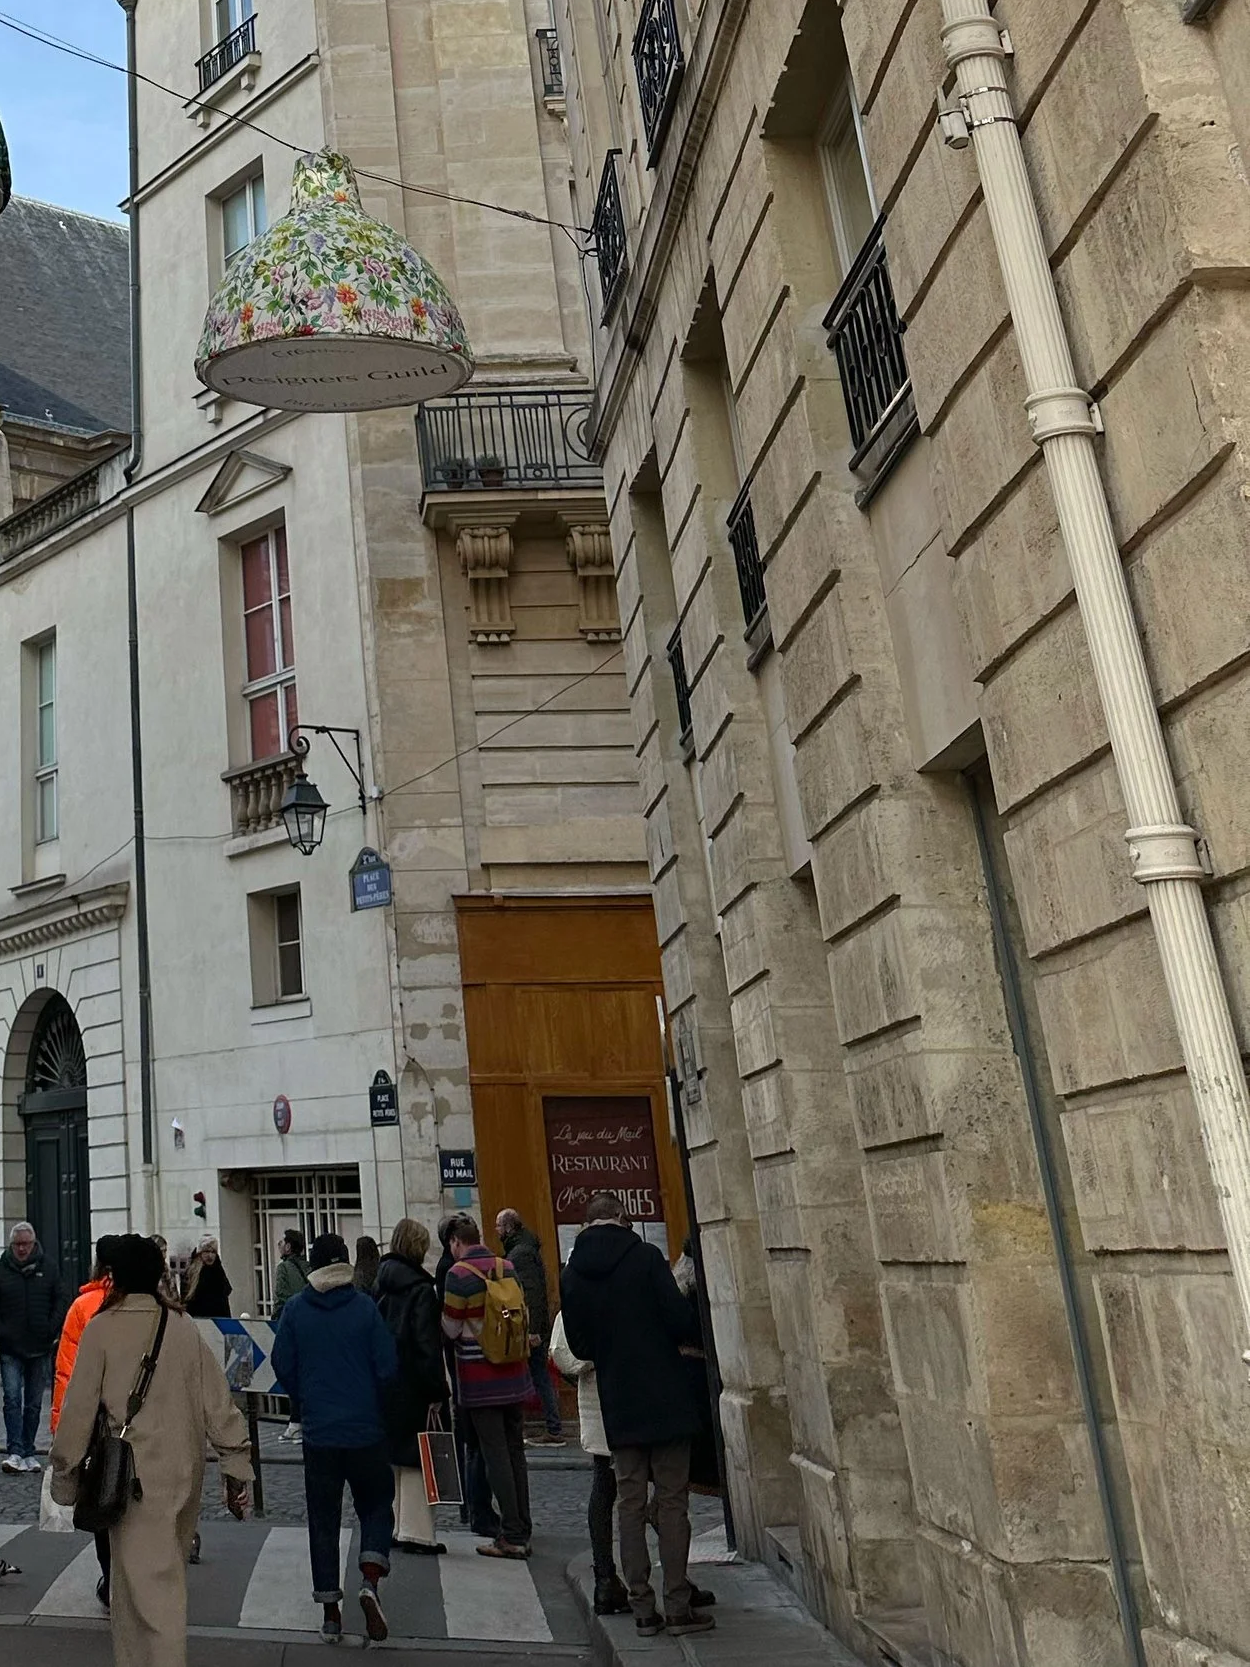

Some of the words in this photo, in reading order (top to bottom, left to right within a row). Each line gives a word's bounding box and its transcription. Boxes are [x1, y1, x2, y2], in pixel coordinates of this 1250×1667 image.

[221, 373, 360, 386] Designers
[367, 363, 448, 381] Guild
[362, 871, 380, 884] PLACE
[596, 1127, 615, 1140] du
[450, 1157, 466, 1168] RUE
[552, 1154, 650, 1175] RESTAURANT
[443, 1168, 454, 1178] DU
[455, 1168, 474, 1178] MAIL
[591, 1188, 655, 1215] RGES
